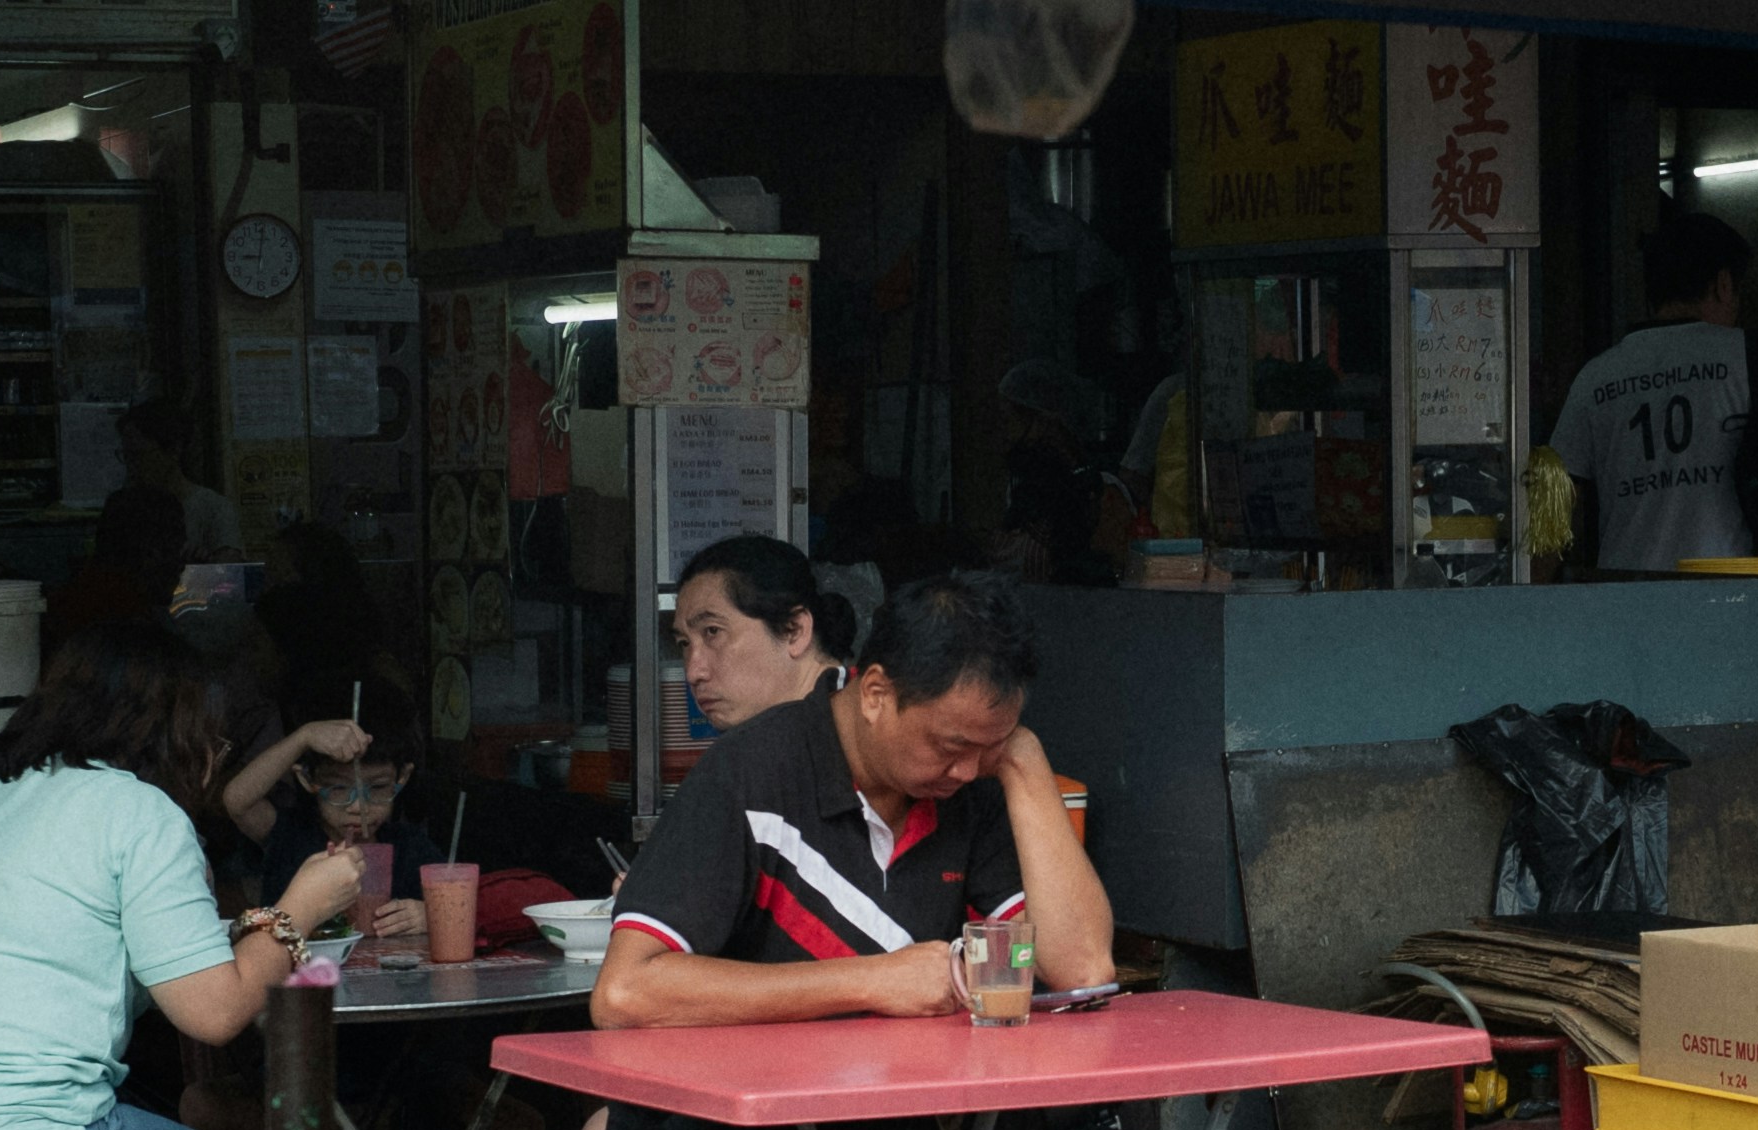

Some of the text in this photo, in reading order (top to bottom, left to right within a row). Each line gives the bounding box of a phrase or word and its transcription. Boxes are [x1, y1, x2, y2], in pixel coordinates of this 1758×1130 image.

[1427, 27, 1509, 244] 哇麵
[1203, 162, 1354, 225] JAWA MEE
[1593, 363, 1729, 405] DEUTSCHLAND
[681, 415, 718, 427] MENU
[1629, 394, 1693, 462] 10
[1617, 465, 1725, 497] GERMANY
[1682, 1033, 1732, 1058] CASTLE
[1735, 1074, 1747, 1089] 24
